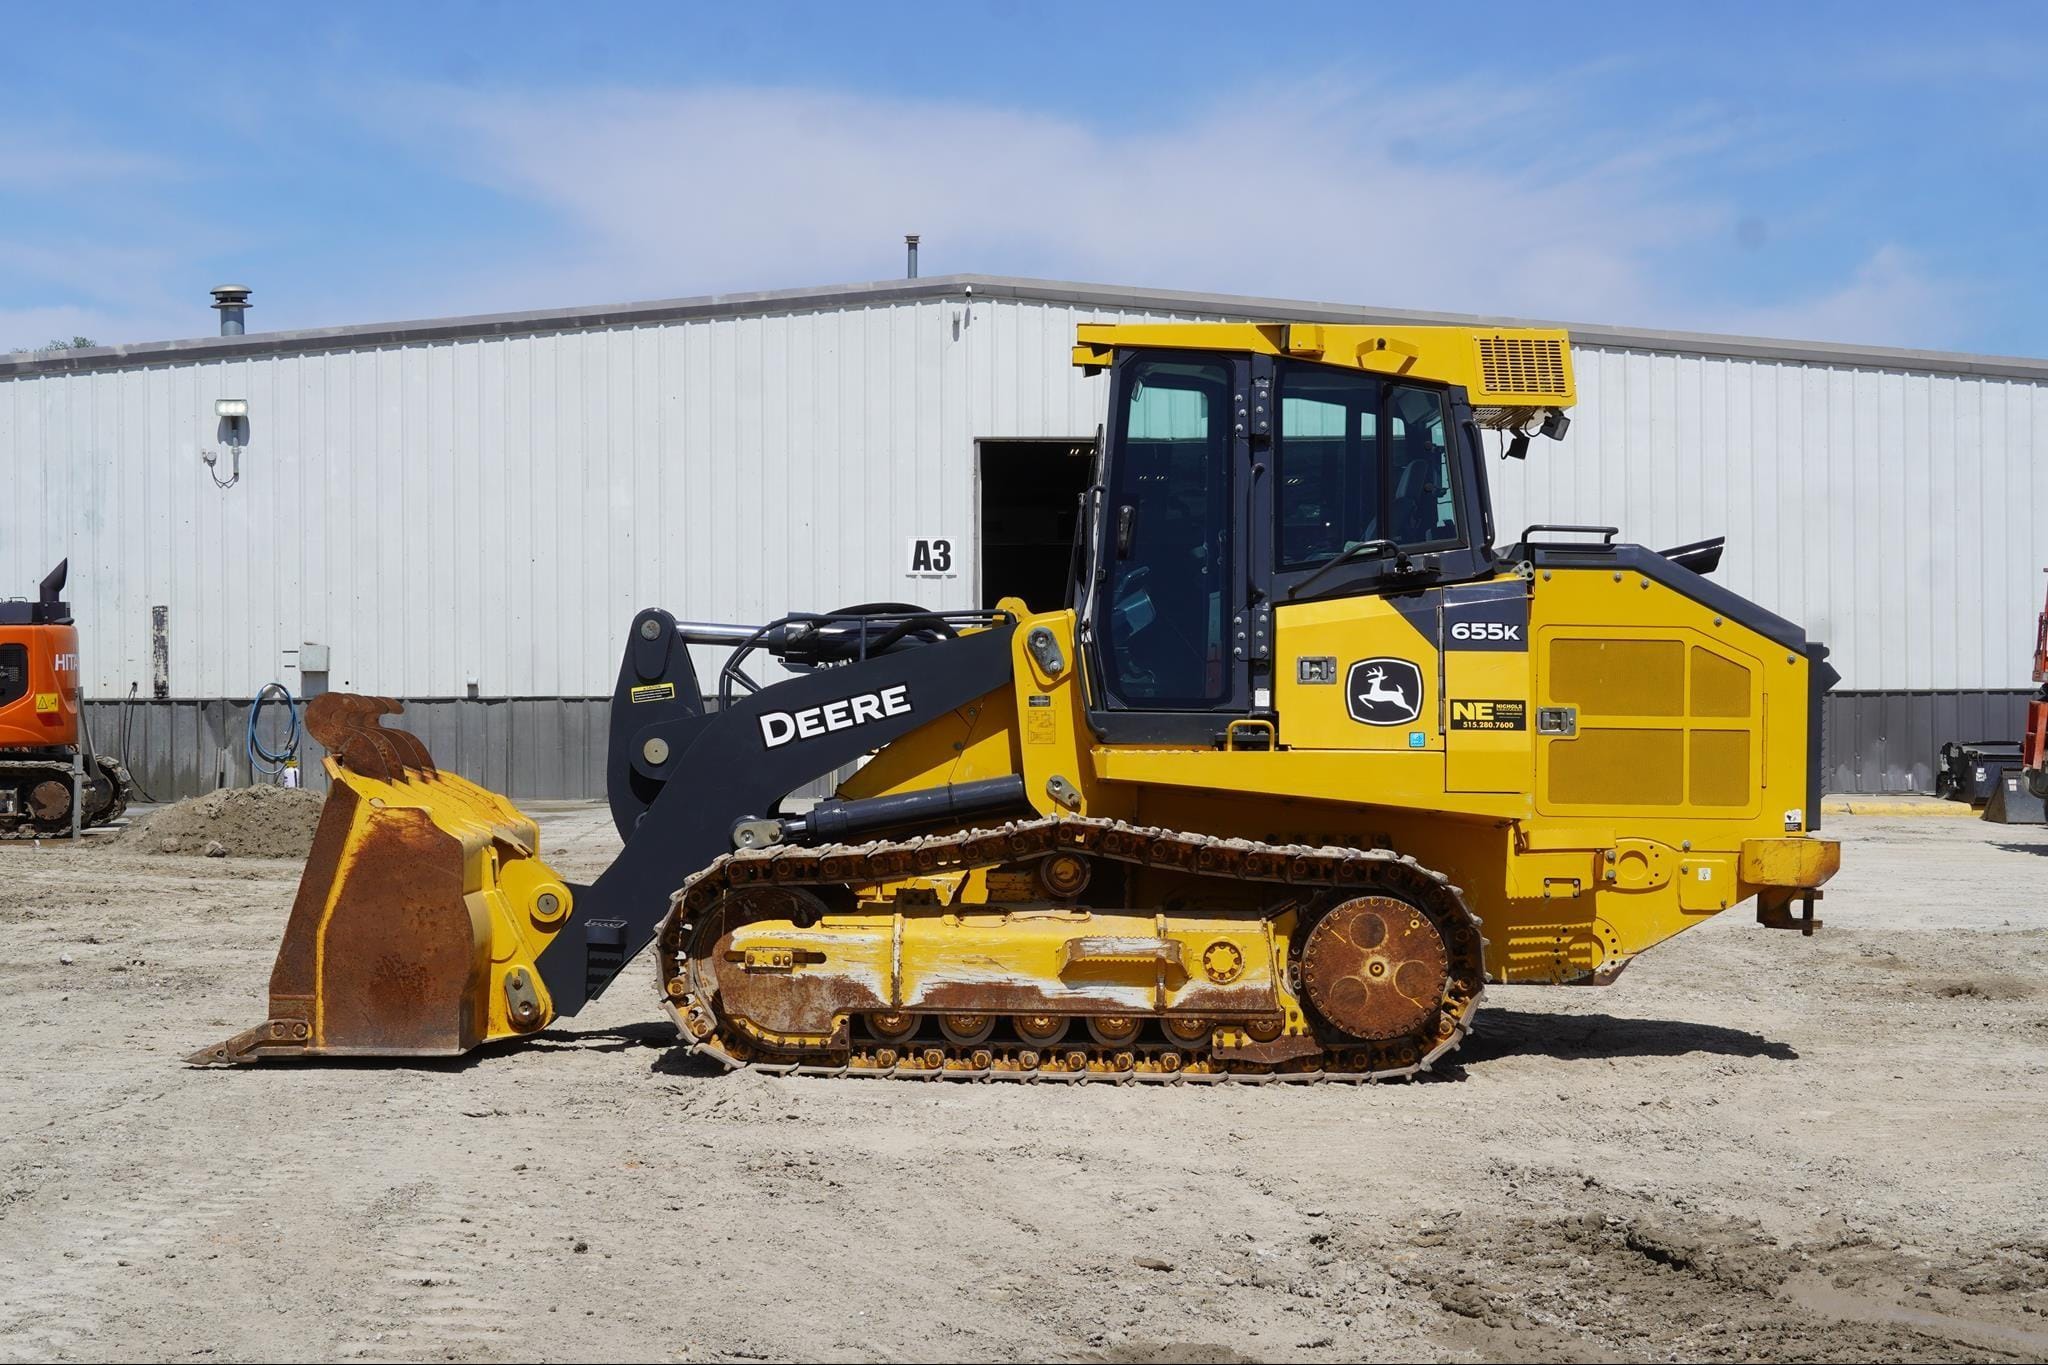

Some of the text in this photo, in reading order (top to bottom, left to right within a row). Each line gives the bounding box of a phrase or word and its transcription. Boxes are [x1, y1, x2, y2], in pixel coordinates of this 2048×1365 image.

[912, 540, 951, 571] A3
[1451, 622, 1520, 640] 655K
[760, 685, 911, 748] DEERE
[1453, 702, 1494, 720] NE
